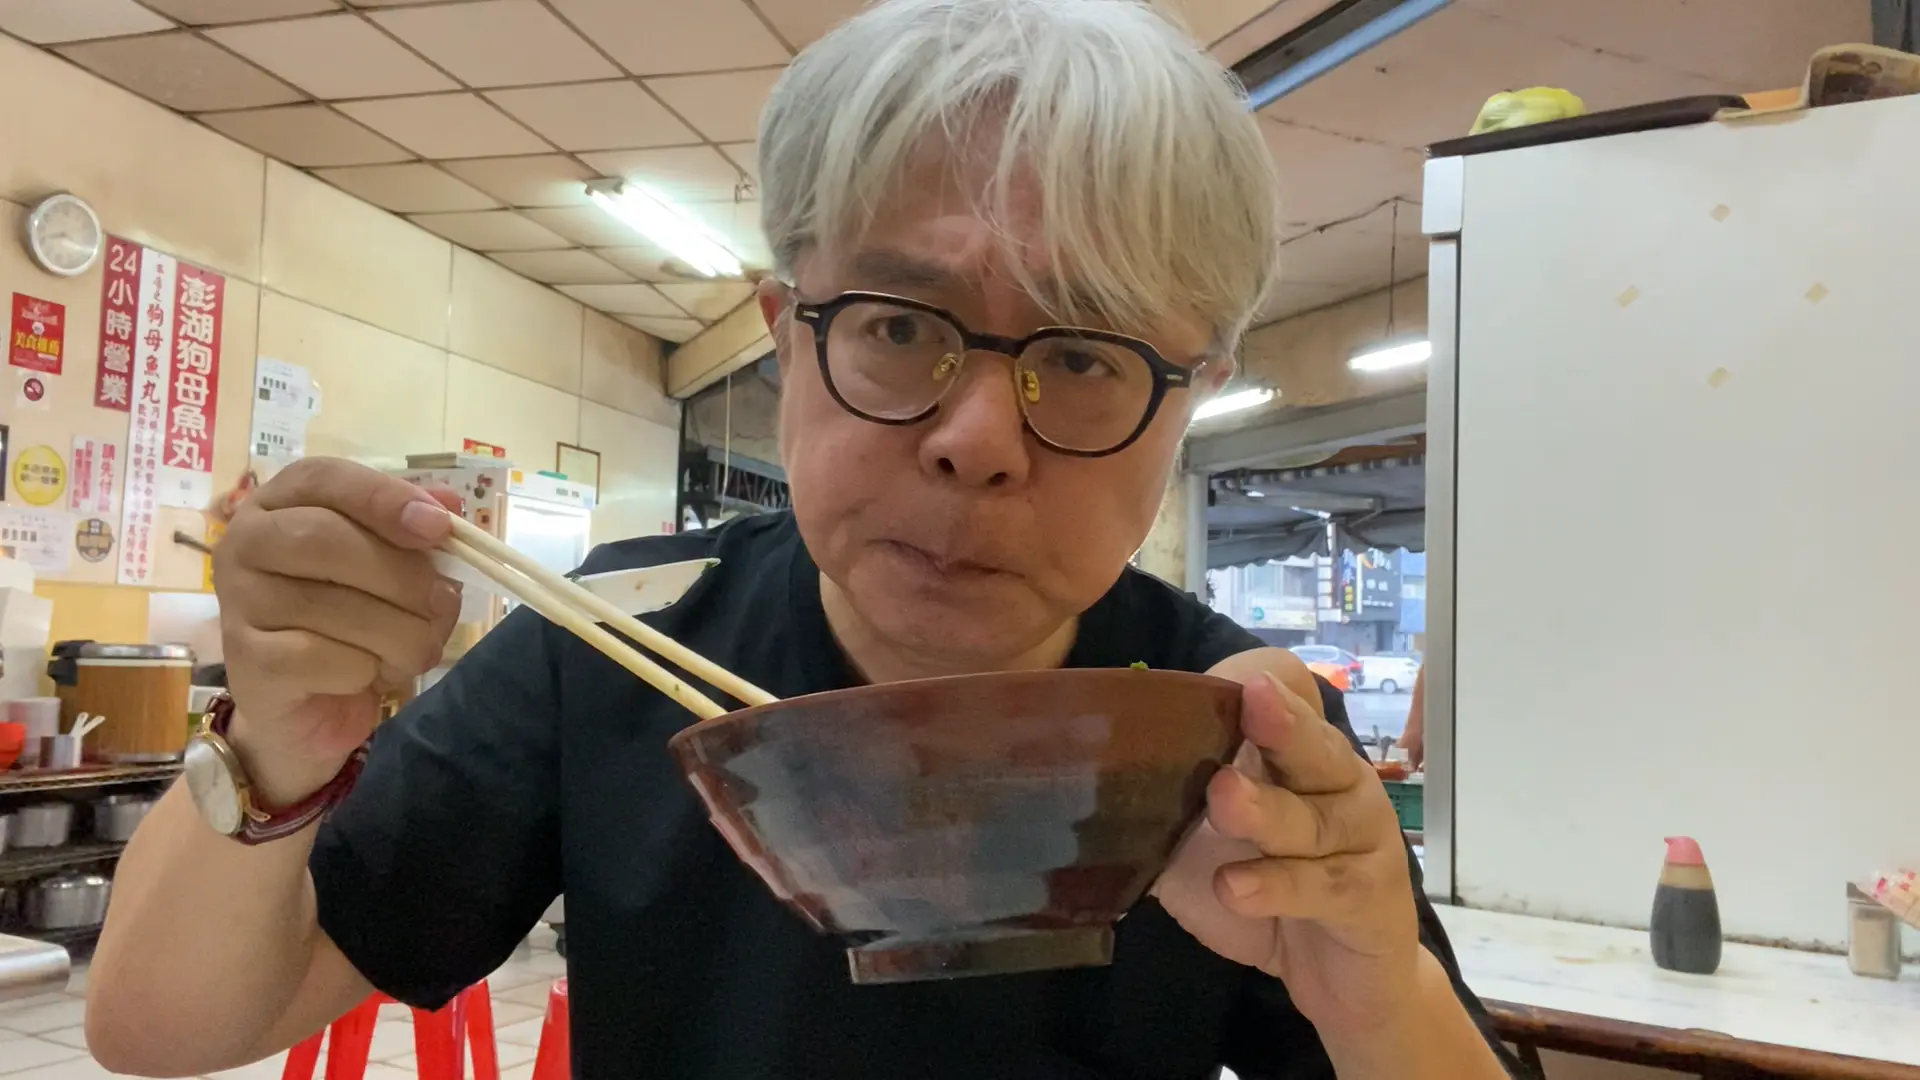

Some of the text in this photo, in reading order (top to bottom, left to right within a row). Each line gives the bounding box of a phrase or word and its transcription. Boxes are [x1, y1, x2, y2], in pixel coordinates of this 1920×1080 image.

[100, 244, 137, 406] 24小時營業
[167, 273, 217, 472] 澎湖狗母魚丸
